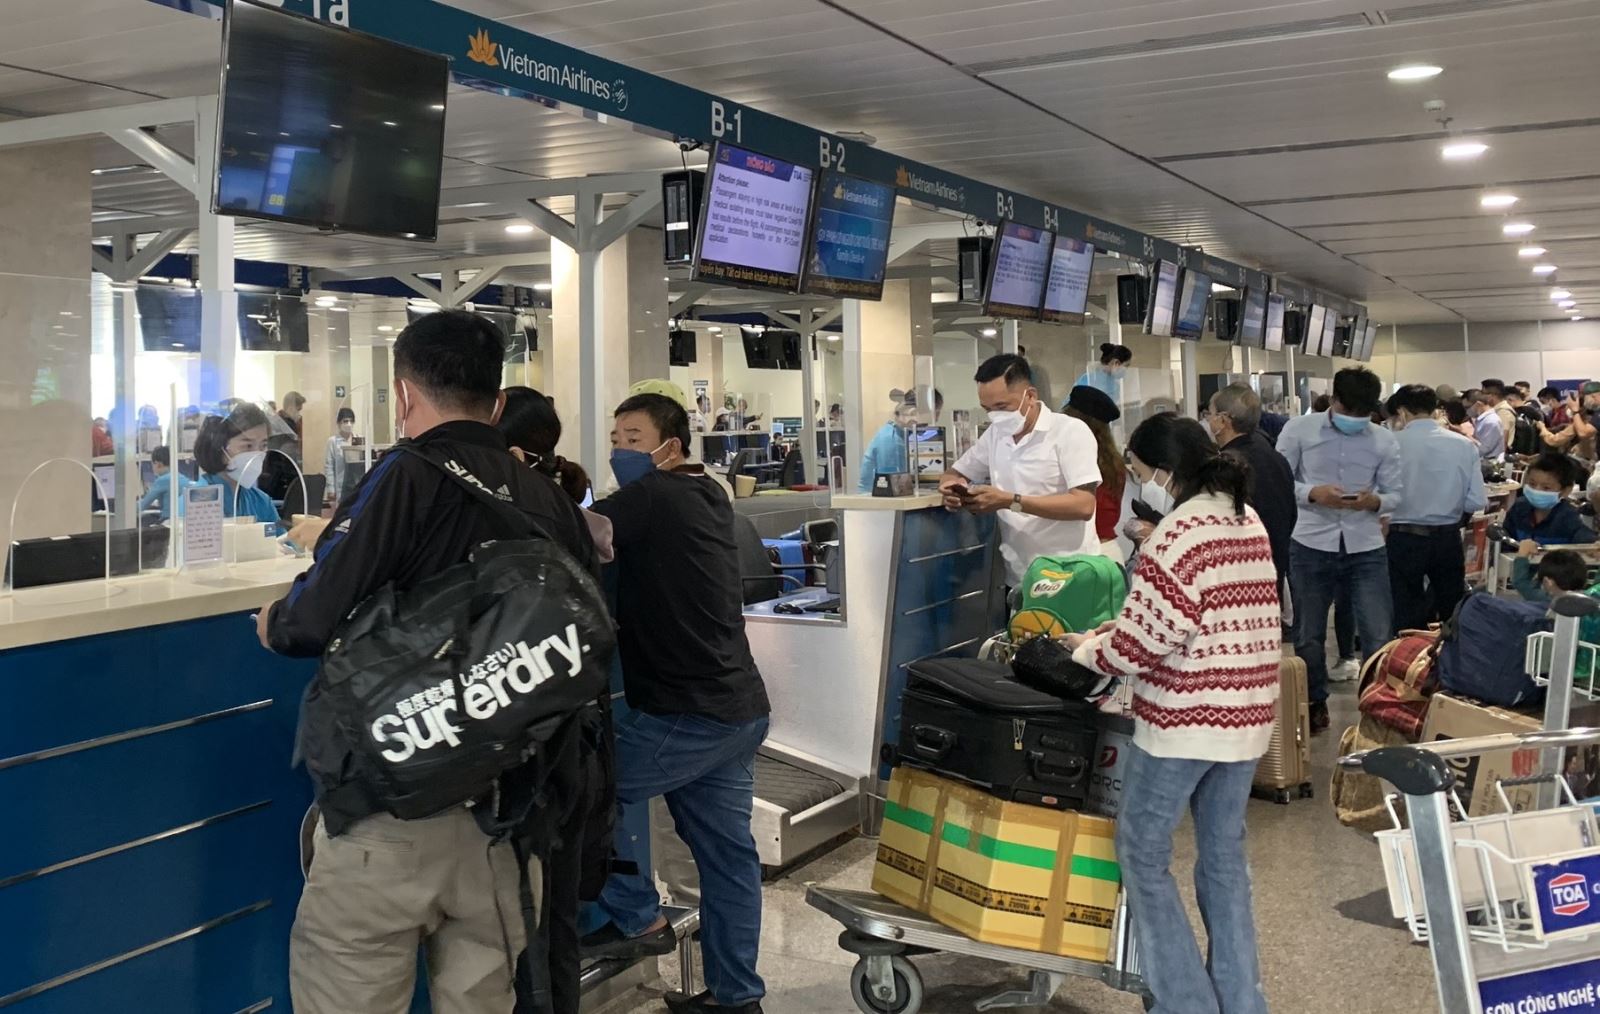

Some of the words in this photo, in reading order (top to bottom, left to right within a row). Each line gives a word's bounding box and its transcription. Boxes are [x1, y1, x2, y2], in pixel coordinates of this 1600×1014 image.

[712, 101, 742, 144] B-1
[820, 136, 846, 173] B-2
[997, 192, 1014, 220] B-3
[1044, 206, 1059, 232] B-4
[1553, 884, 1586, 905] TOA
[1518, 995, 1556, 1014] CÔNG
[1557, 983, 1595, 1008] NGHỆ
